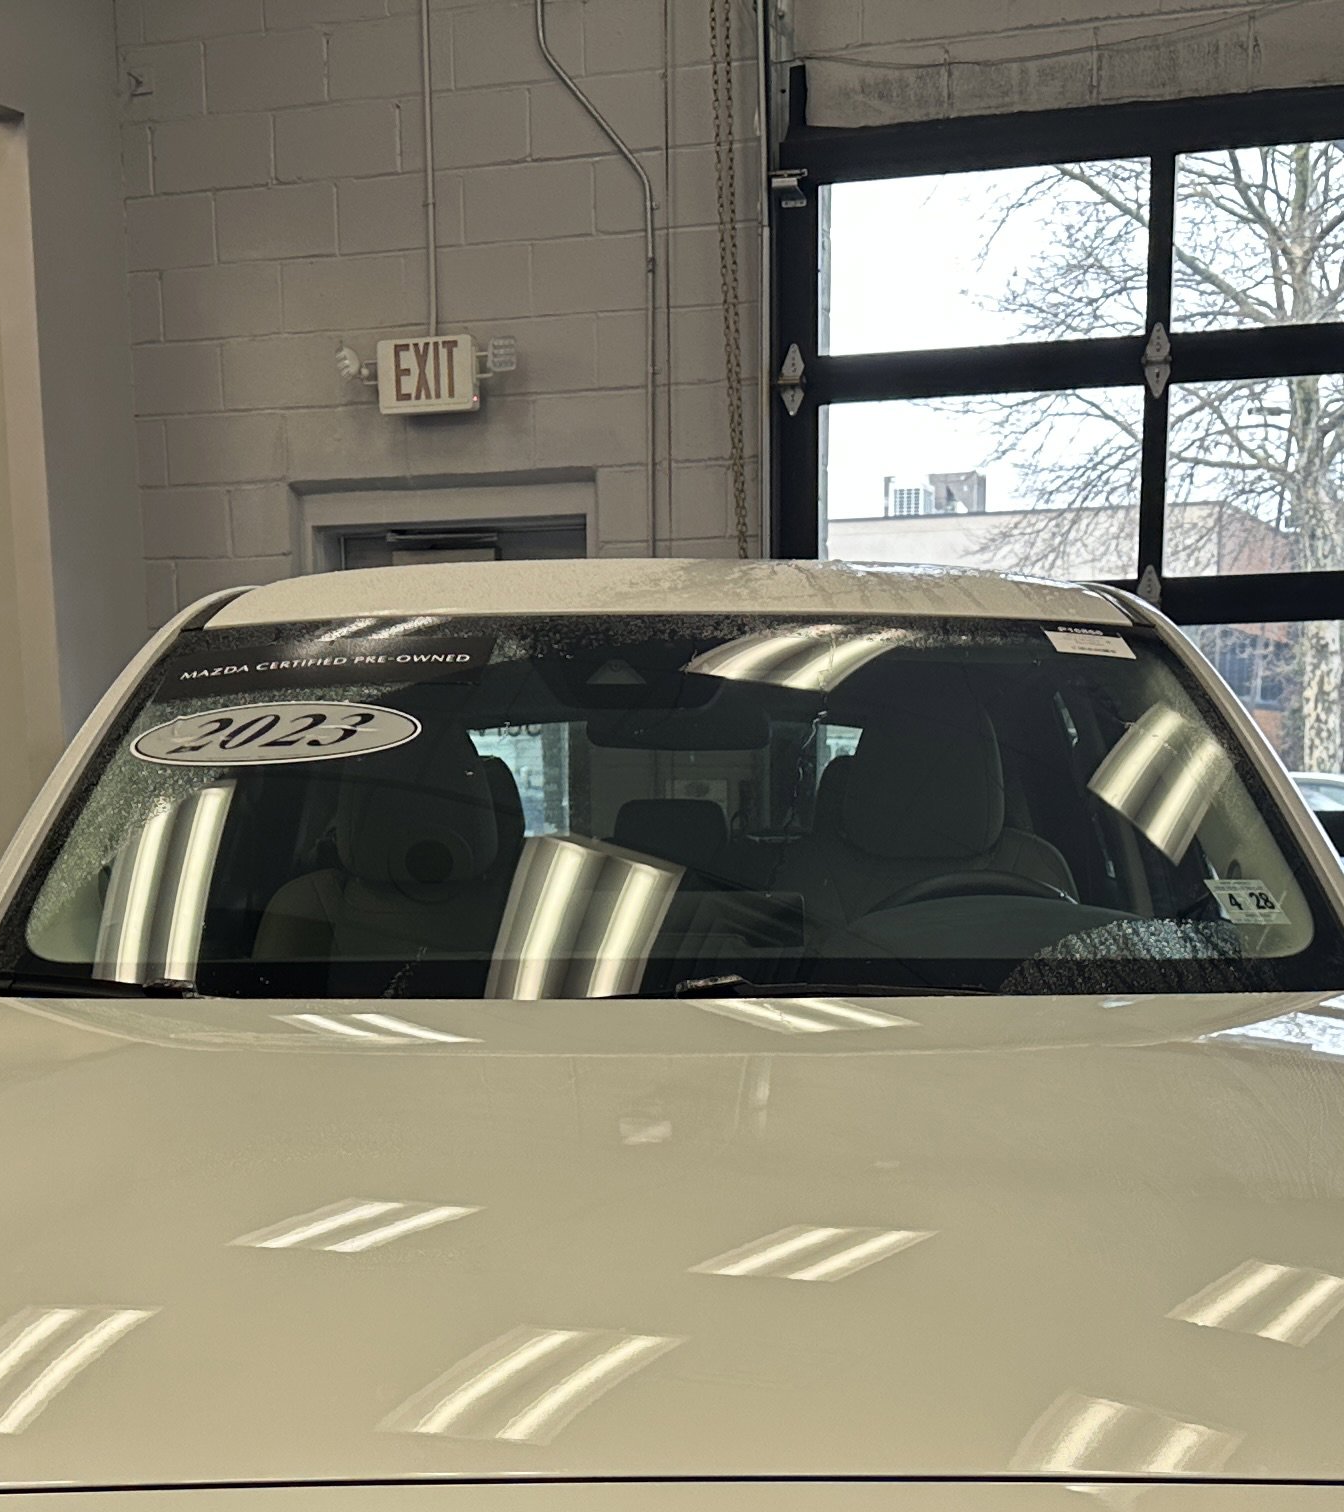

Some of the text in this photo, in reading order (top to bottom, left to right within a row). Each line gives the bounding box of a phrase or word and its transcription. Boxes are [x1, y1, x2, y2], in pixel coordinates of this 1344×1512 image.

[394, 340, 458, 401] EXIT
[180, 653, 471, 680] MAZDA CERTIFIED PRE-OWNED
[166, 713, 376, 754] 2023
[1228, 892, 1276, 910] 4 28
